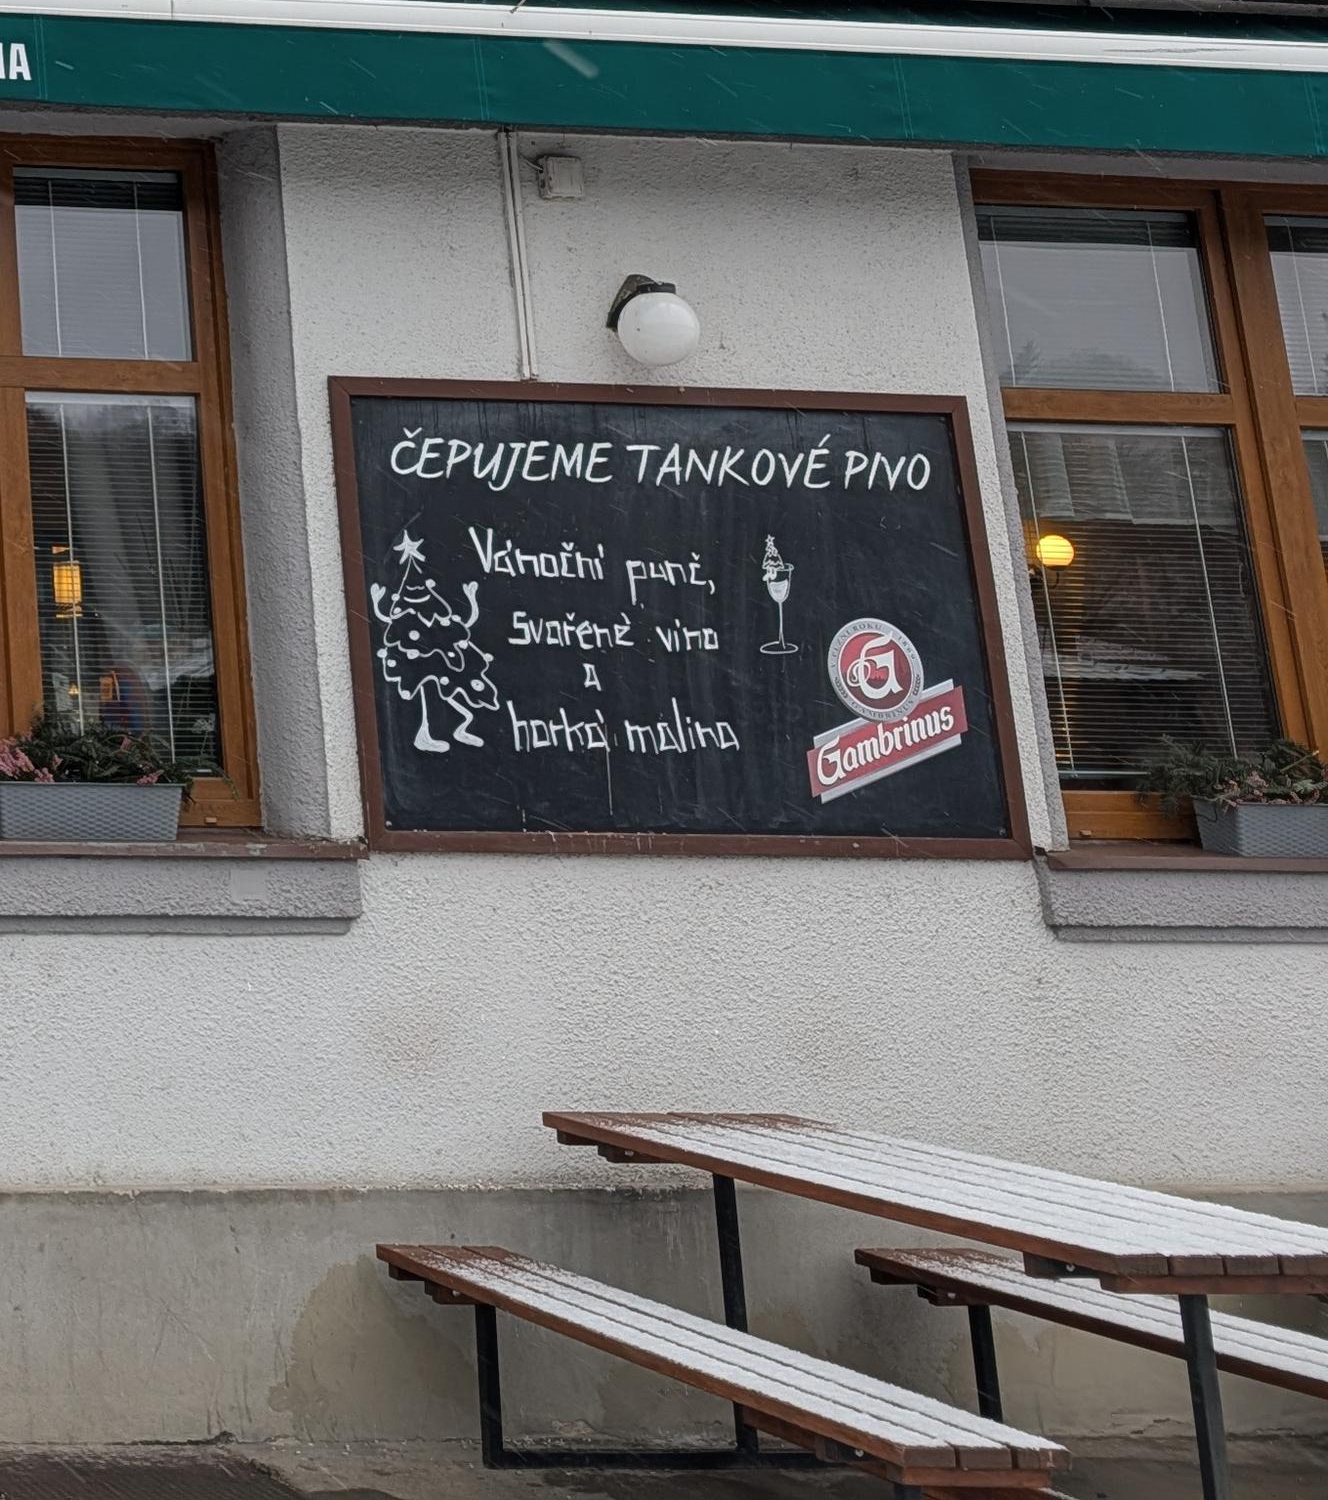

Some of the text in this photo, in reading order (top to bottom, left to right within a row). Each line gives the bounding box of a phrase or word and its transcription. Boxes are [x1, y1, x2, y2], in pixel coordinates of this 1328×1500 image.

[390, 427, 931, 492] ČEPUJEME TANKOVÉ PIVO
[468, 526, 716, 606] Vánoční punč,
[508, 611, 635, 650] Svařené
[507, 697, 740, 755] horká malina
[816, 704, 955, 786] Gambrinus
